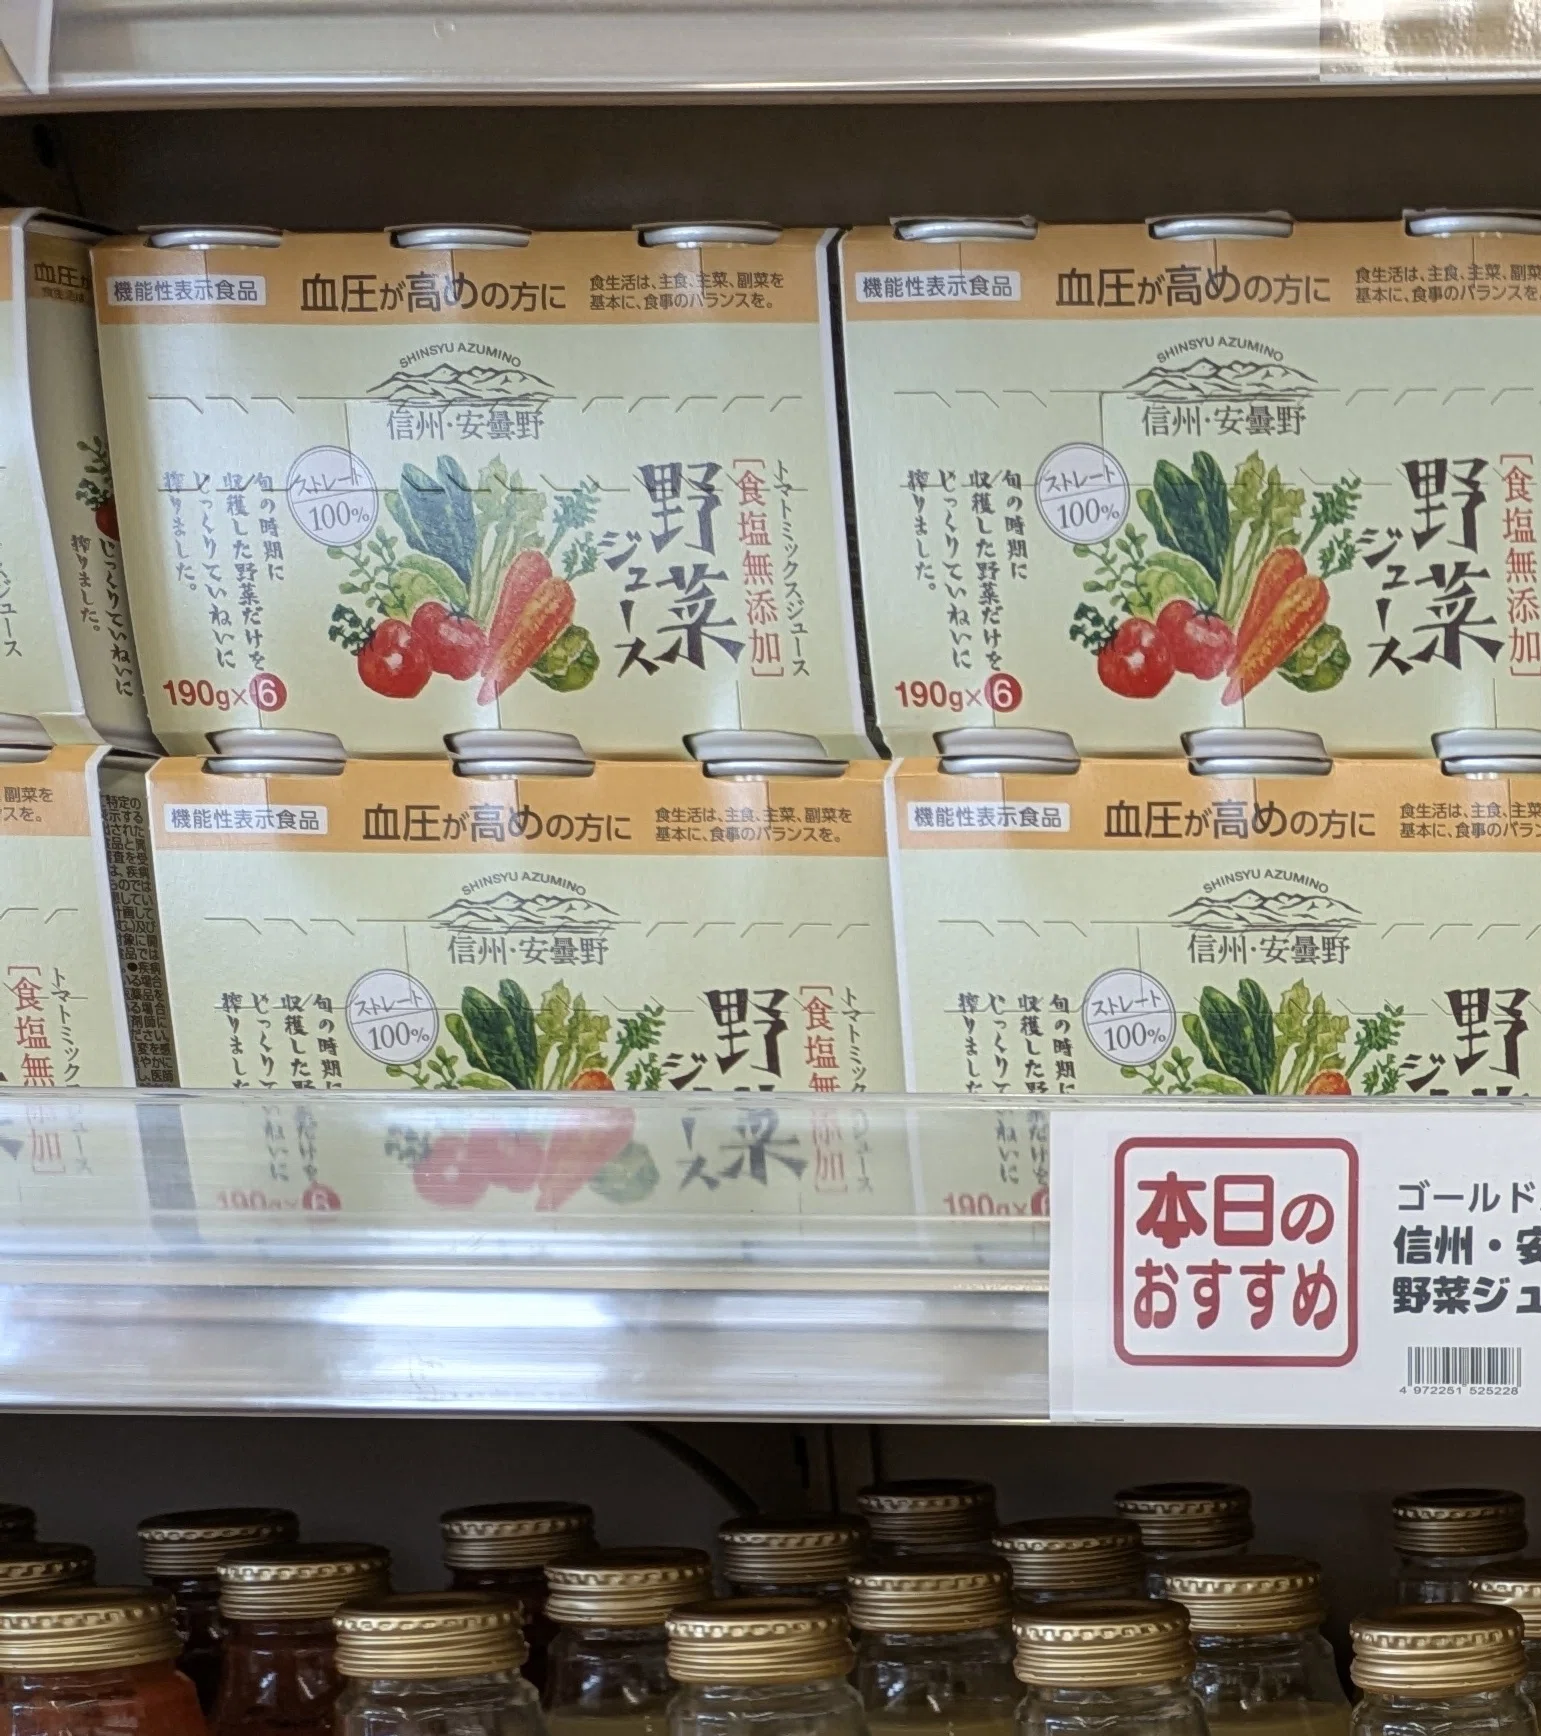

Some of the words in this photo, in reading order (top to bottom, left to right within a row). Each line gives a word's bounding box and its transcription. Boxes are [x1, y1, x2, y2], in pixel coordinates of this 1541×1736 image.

[114, 279, 258, 303] 機能性表示食品
[301, 272, 565, 314] 血圧が高めの方に
[589, 293, 773, 311] 基本に、食事のバランスを。
[590, 272, 784, 293] 食生活は、主食、主菜、副菜を
[862, 275, 1012, 298] 機能性表示食品
[1055, 265, 1330, 308] 血圧が高めの方に
[1156, 335, 1216, 363] SHINSYU
[1218, 335, 1284, 362] AZUMINO
[637, 461, 744, 669] 野菜
[1404, 457, 1503, 669] 野菜
[1355, 526, 1415, 677] ジュース
[172, 809, 321, 831] 機能性表示食品
[363, 802, 631, 844] 血圧が高めの方に
[915, 806, 1062, 828] 機能性表示食品
[1104, 799, 1376, 840] 血圧が高めの方に
[1136, 1171, 1334, 1248] 本日の
[1134, 1258, 1338, 1330] おすすめ
